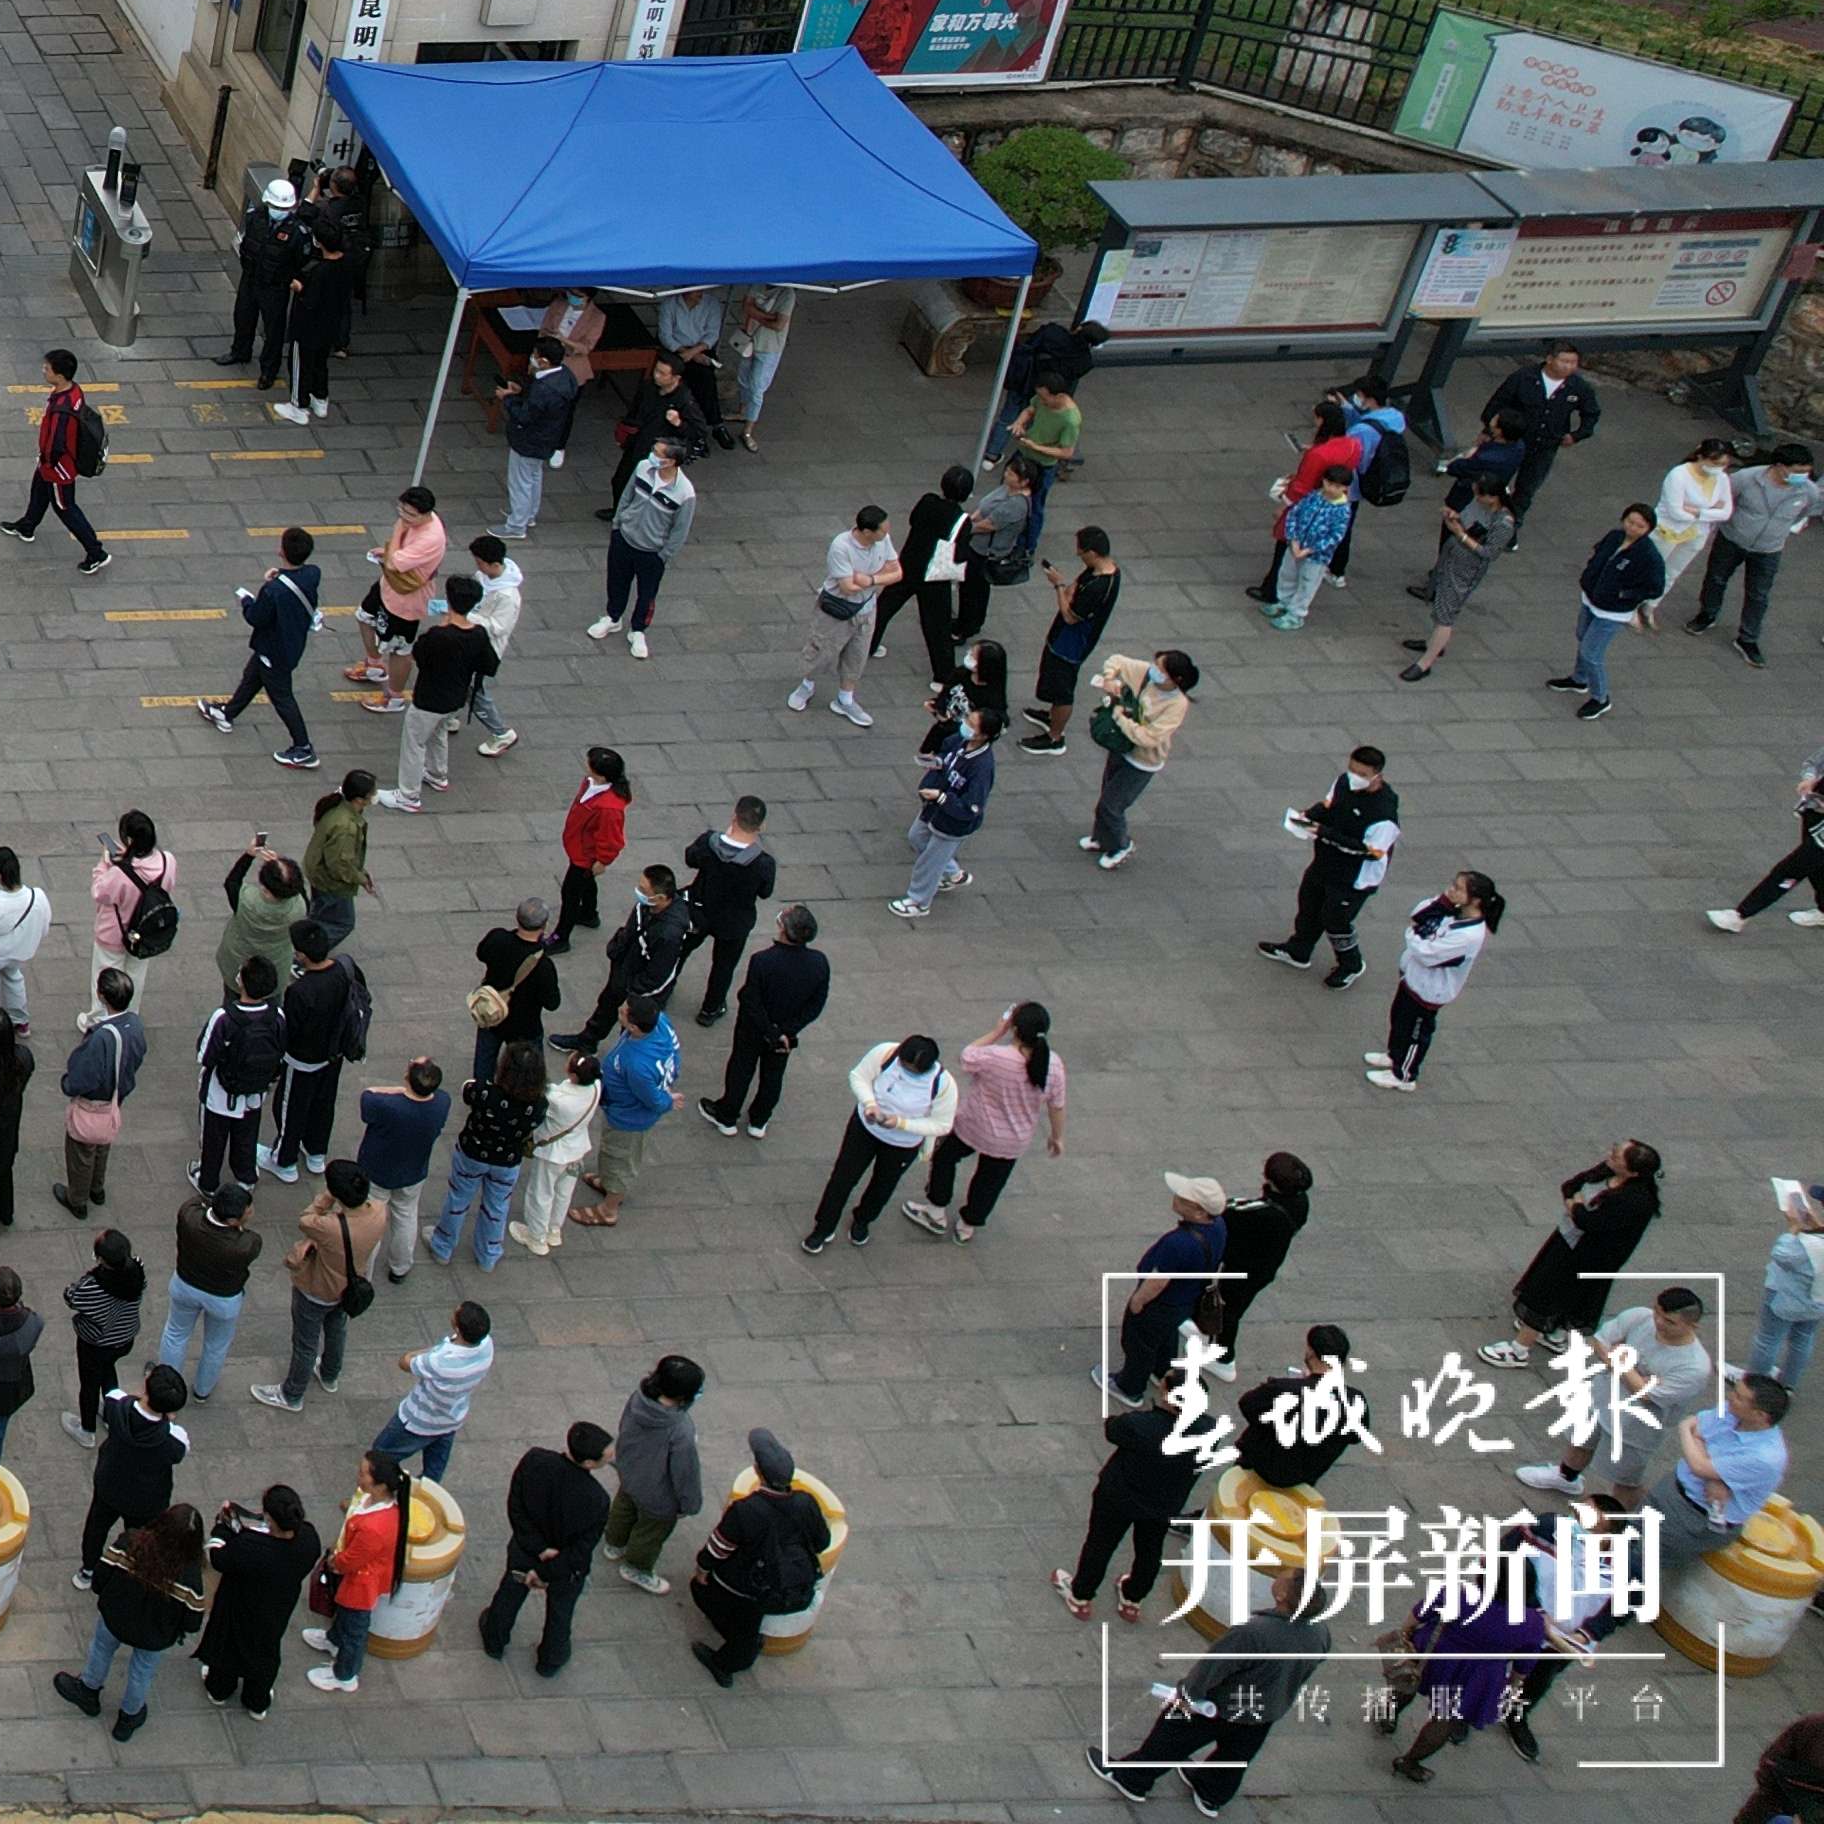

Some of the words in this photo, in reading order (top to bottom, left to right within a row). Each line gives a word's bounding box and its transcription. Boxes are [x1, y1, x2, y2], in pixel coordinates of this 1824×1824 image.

[929, 12, 1020, 33] 家和万事兴
